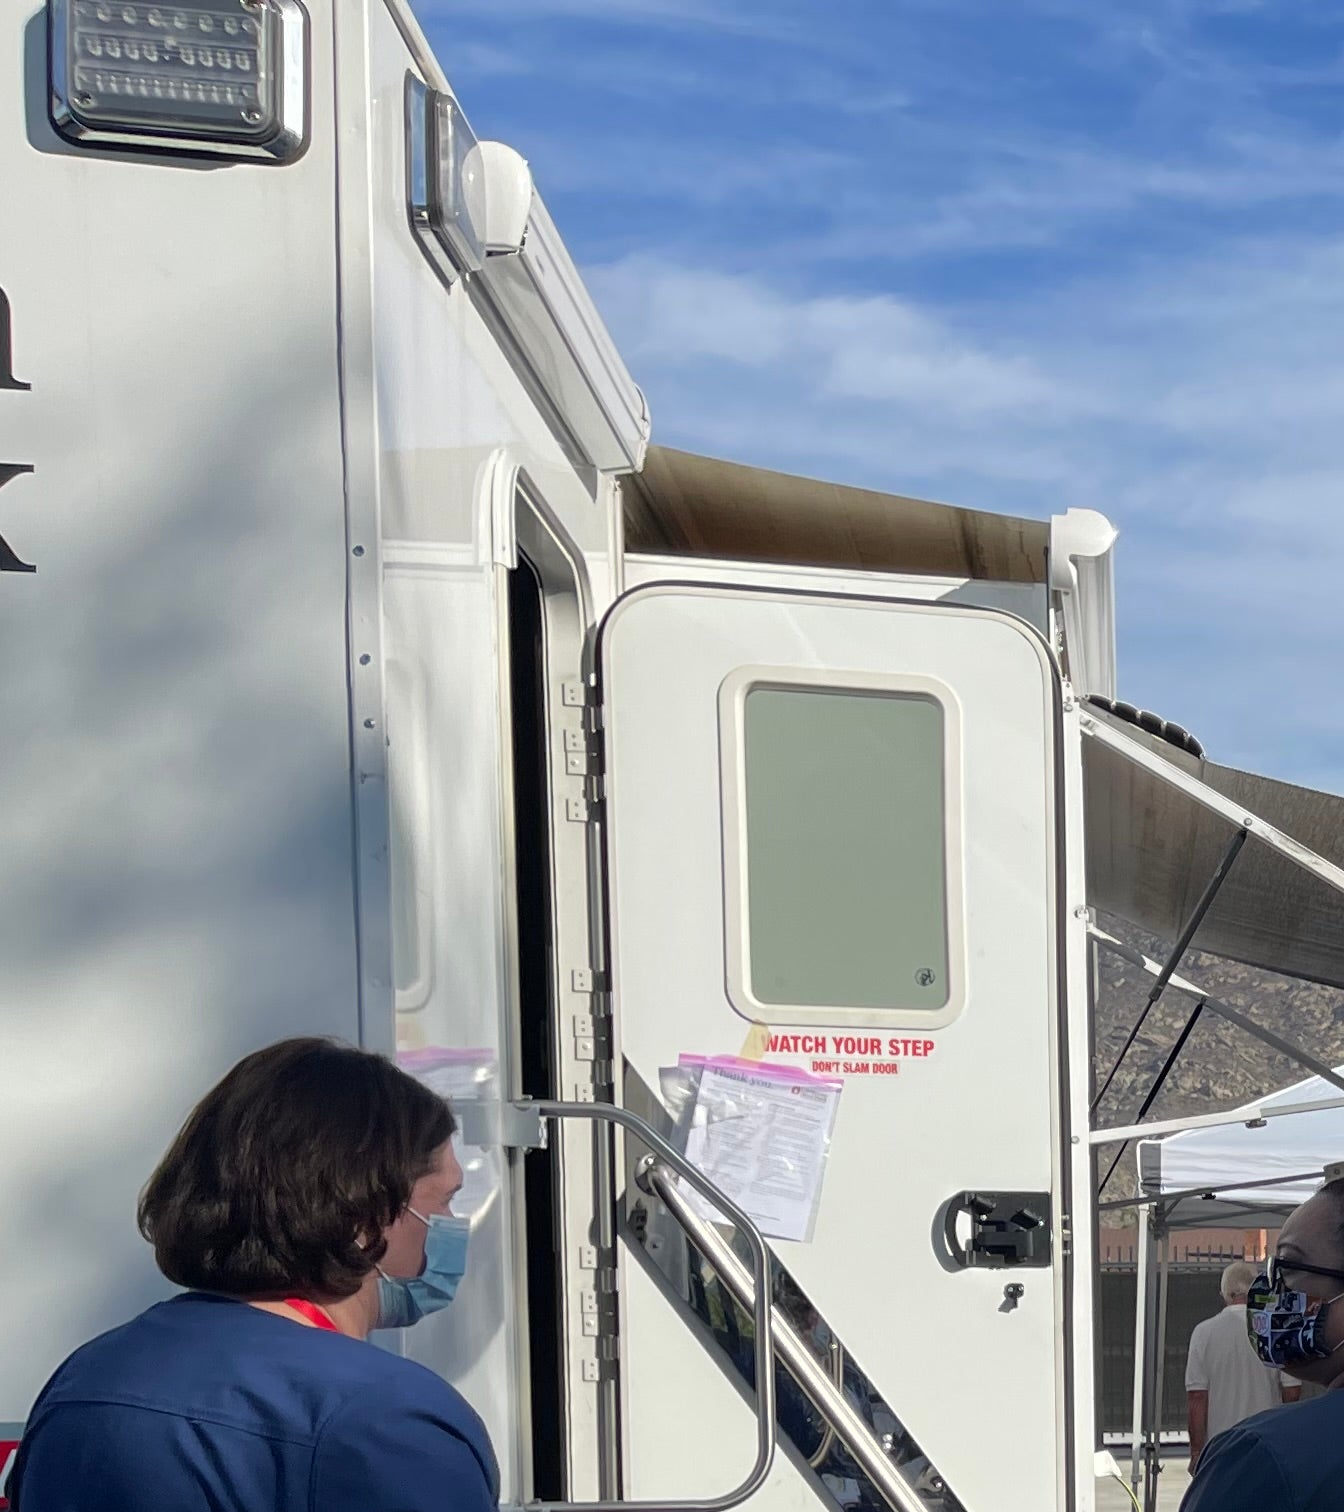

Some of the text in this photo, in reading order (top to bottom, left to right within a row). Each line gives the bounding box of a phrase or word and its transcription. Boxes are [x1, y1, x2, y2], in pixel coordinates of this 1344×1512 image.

[763, 1034, 935, 1057] WATCH YOUR STEP
[811, 1060, 898, 1075] DON'T SLAM DOOR
